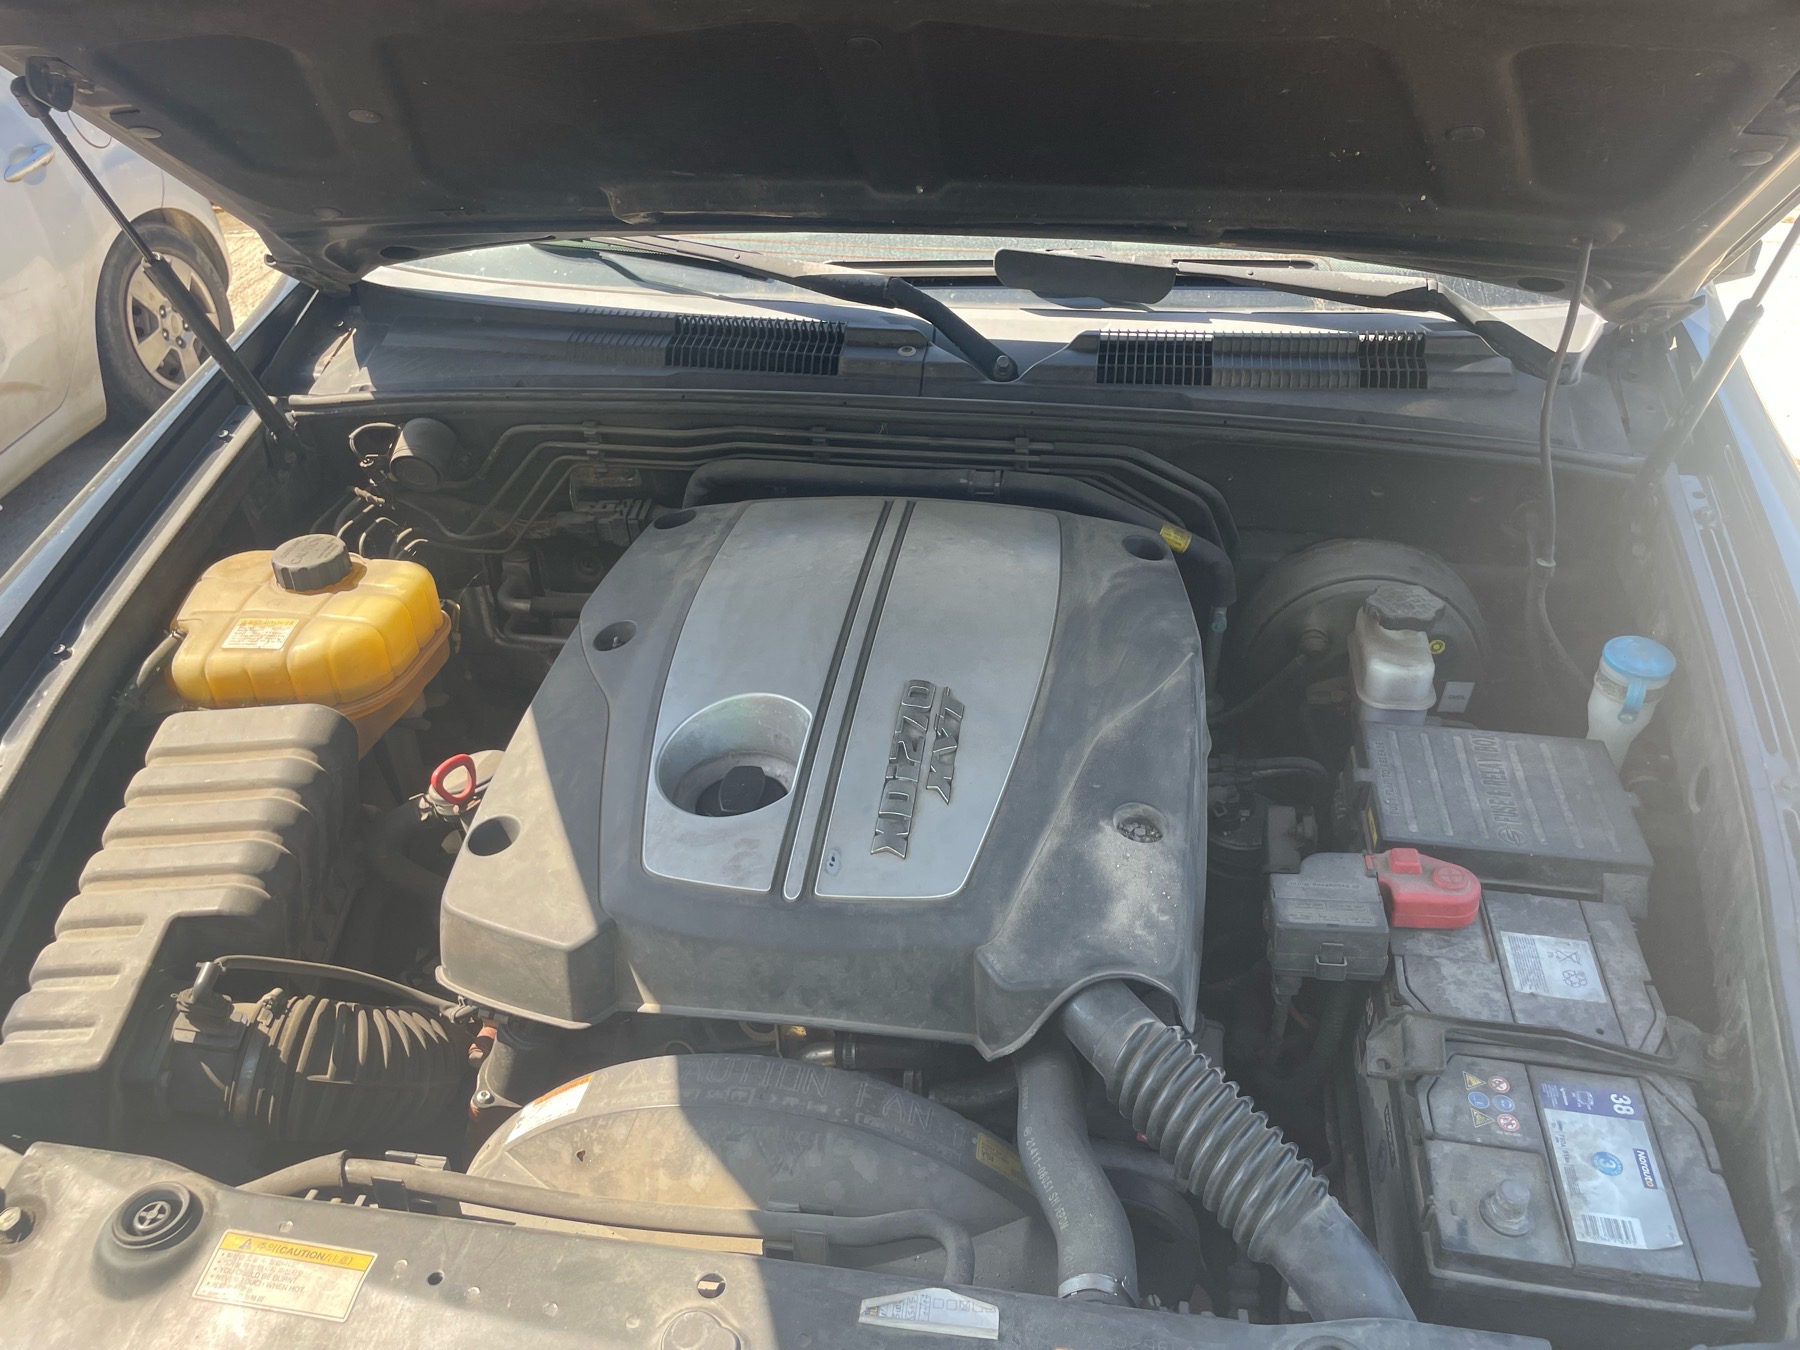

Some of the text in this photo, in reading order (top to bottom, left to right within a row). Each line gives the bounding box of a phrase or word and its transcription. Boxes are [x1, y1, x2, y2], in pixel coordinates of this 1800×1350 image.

[1469, 733, 1500, 752] BOX
[1473, 757, 1511, 788] RELAY
[1488, 797, 1522, 824] FUSE
[1610, 1093, 1635, 1116] 38
[1636, 1150, 1654, 1188] Norauto
